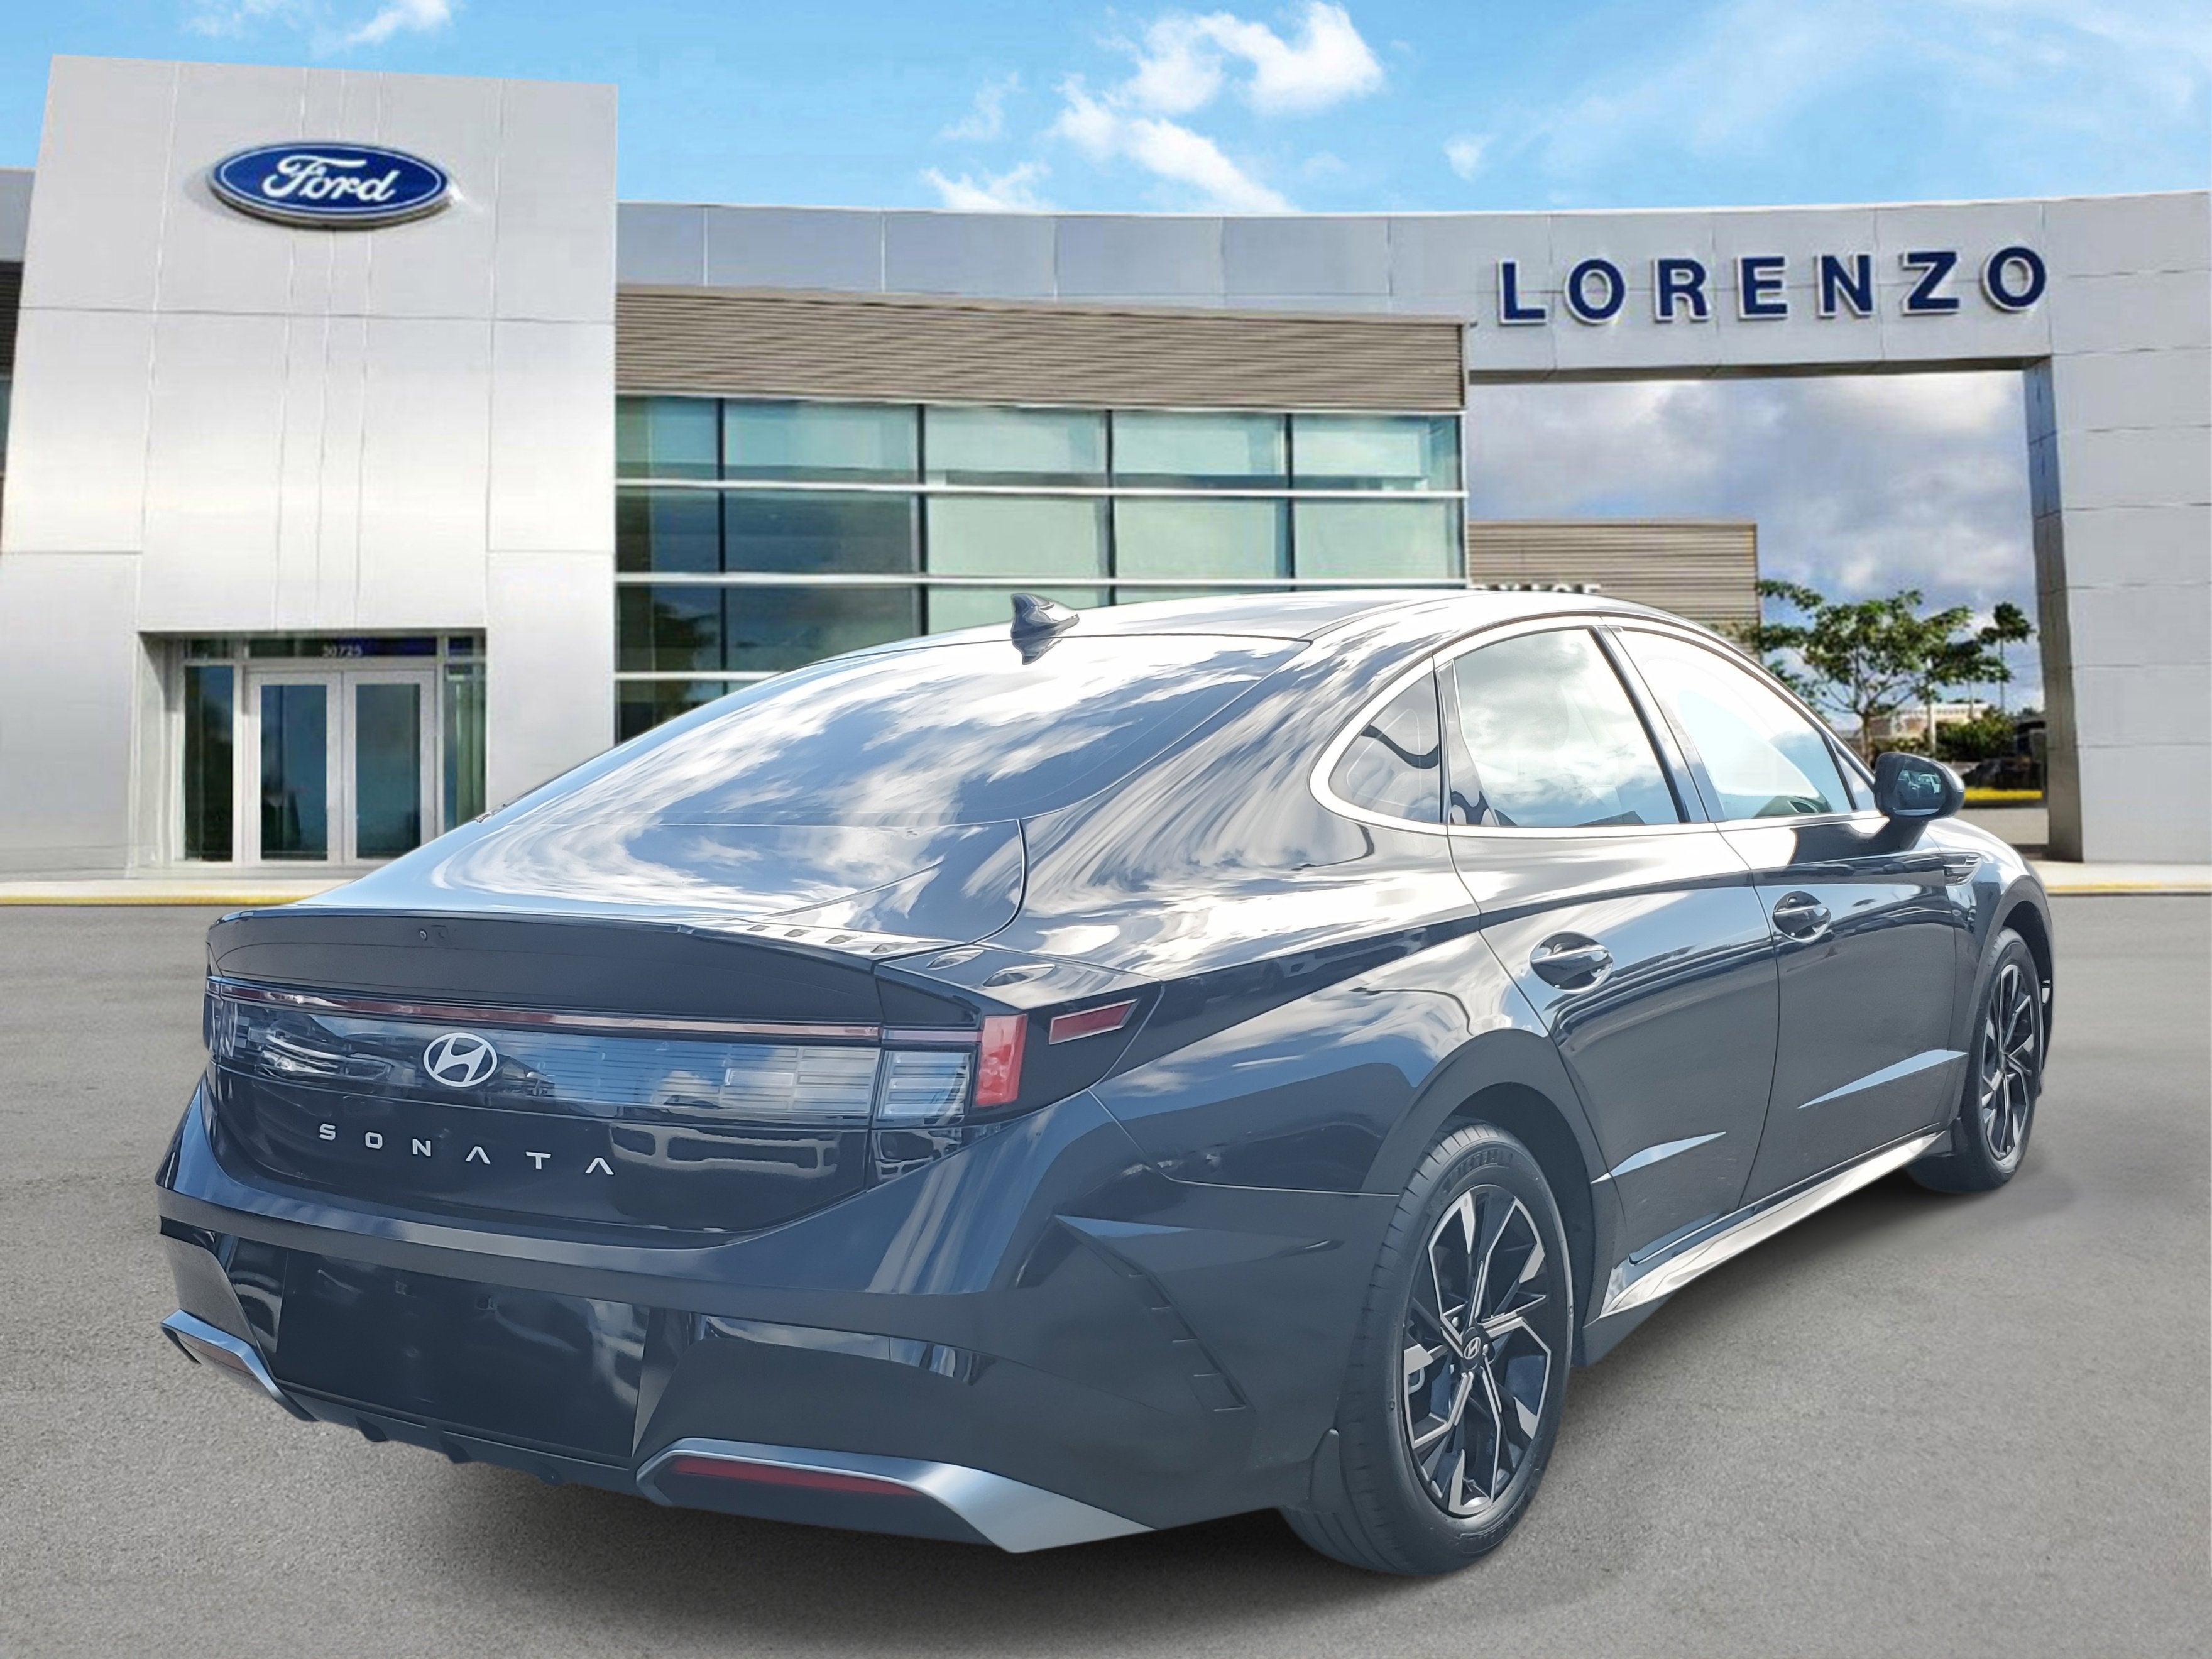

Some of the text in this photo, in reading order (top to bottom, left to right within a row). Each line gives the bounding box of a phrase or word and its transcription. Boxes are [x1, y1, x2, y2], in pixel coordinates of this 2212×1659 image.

[261, 154, 402, 202] Ford
[1499, 246, 2048, 325] LORENZO
[319, 1123, 615, 1176] SONATA
